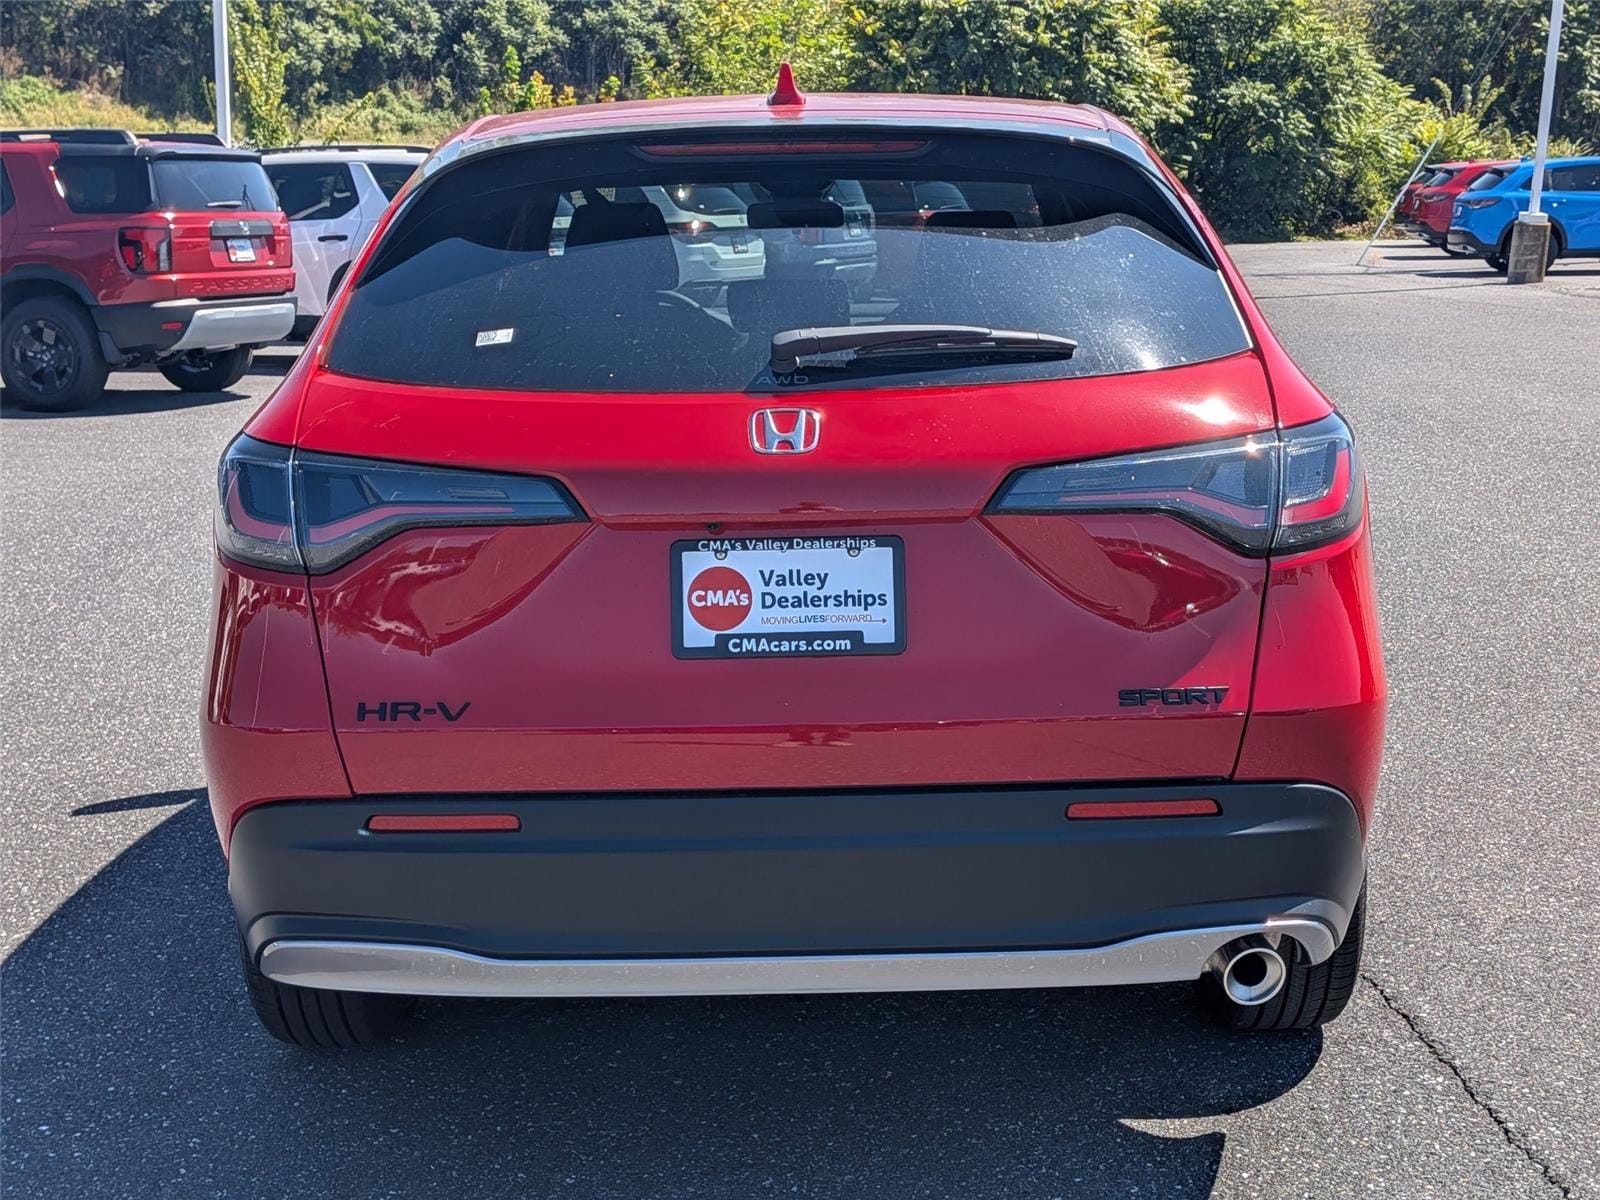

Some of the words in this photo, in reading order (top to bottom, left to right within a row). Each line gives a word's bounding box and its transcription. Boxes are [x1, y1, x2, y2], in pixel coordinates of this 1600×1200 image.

[190, 277, 292, 292] PASSPORT
[756, 374, 808, 384] AWD
[698, 540, 742, 551] CMA's
[746, 540, 789, 552] Valley
[793, 537, 876, 550] Dealerships
[759, 569, 829, 589] Valley
[691, 590, 750, 607] CMA's
[761, 590, 888, 611] Dealerships
[728, 638, 851, 653] CMAcars.com
[1118, 686, 1229, 706] SPORT
[357, 702, 471, 721] HR-V
